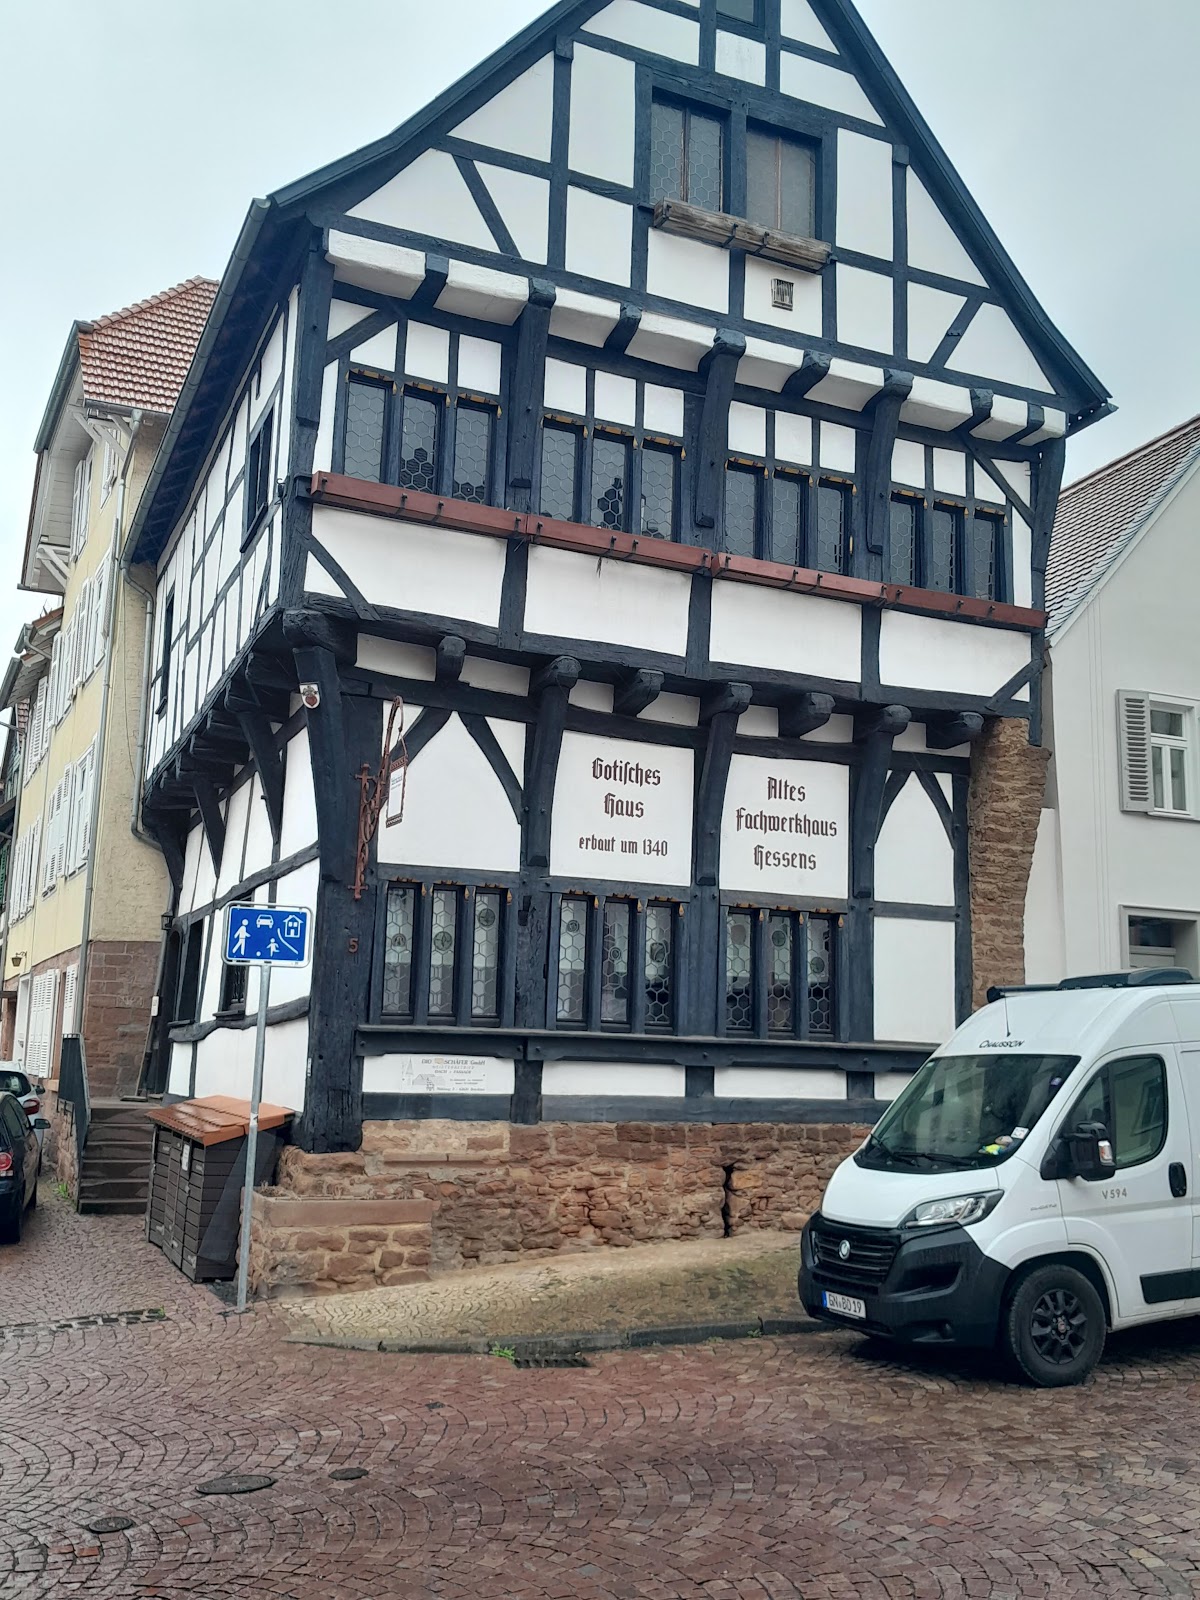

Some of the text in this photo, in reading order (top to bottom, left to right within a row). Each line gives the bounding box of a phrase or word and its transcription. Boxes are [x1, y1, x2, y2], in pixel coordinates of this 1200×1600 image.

[767, 776, 806, 802] Altes
[604, 793, 645, 819] Haus
[736, 807, 838, 837] Fachwerkhaus
[578, 834, 668, 857] erbaut um 1340
[753, 844, 817, 871] Hessens
[348, 937, 359, 953] 5
